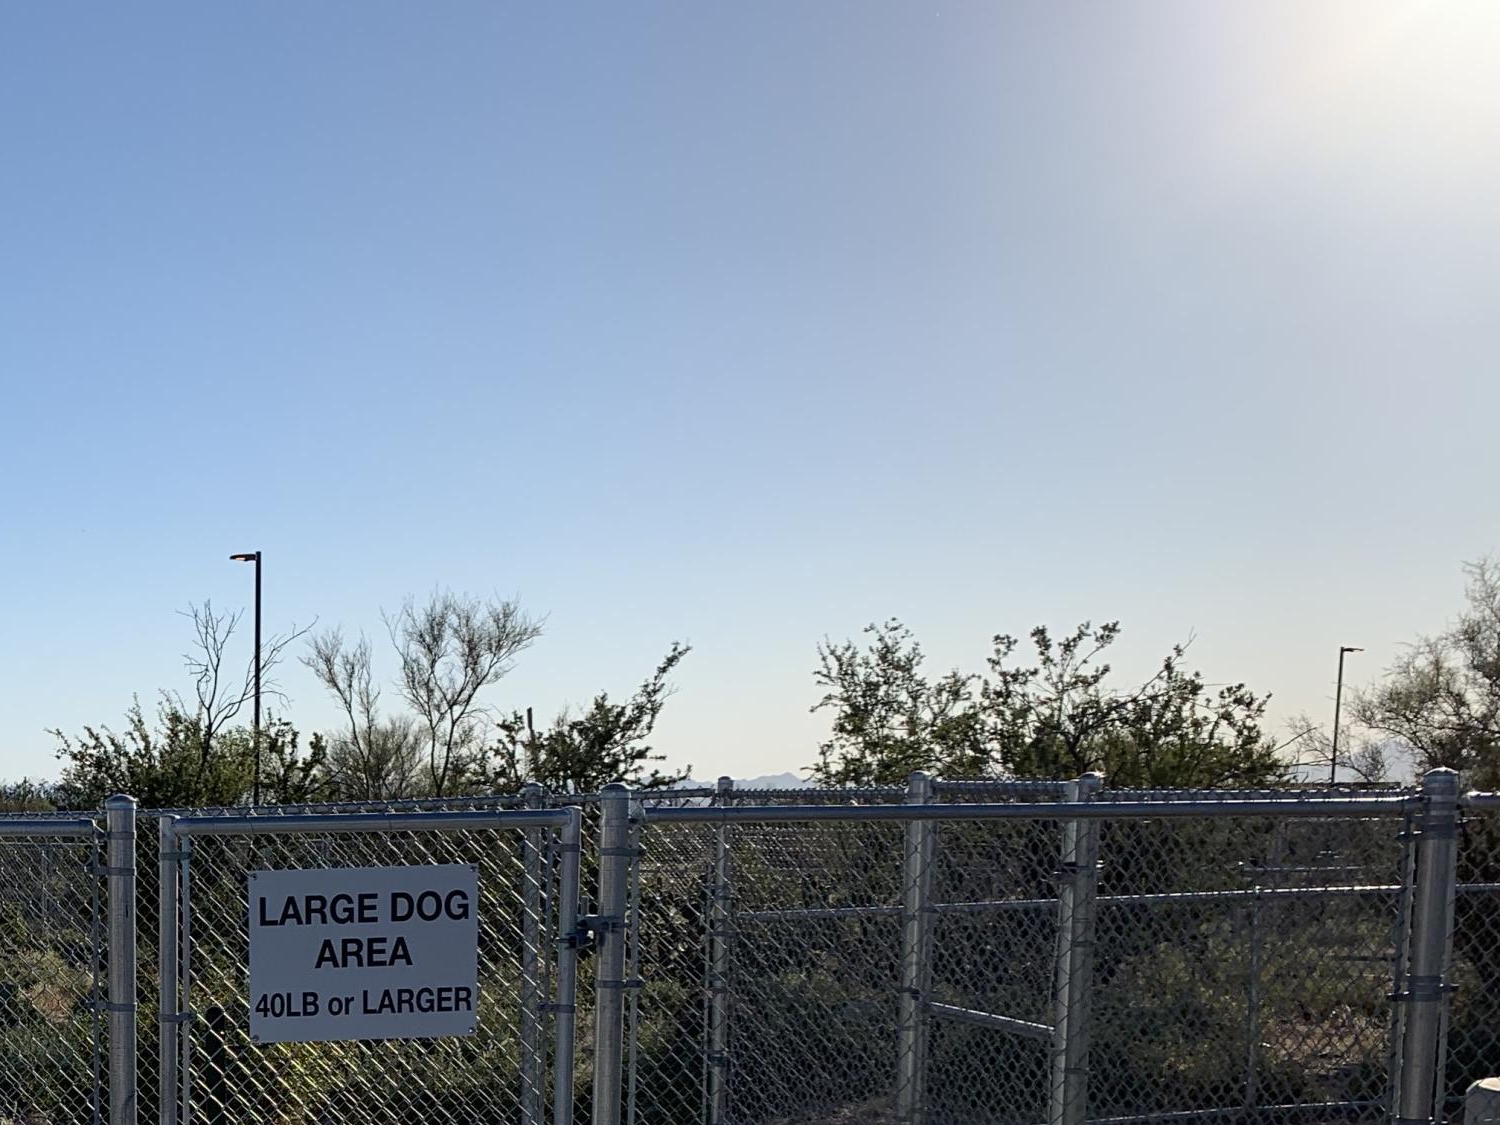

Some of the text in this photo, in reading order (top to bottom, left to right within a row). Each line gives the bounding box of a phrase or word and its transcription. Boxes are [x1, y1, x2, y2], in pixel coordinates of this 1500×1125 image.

[259, 889, 470, 927] LARGE DOG
[314, 936, 413, 969] AREA
[255, 986, 472, 1018] 40LB or LARGER
